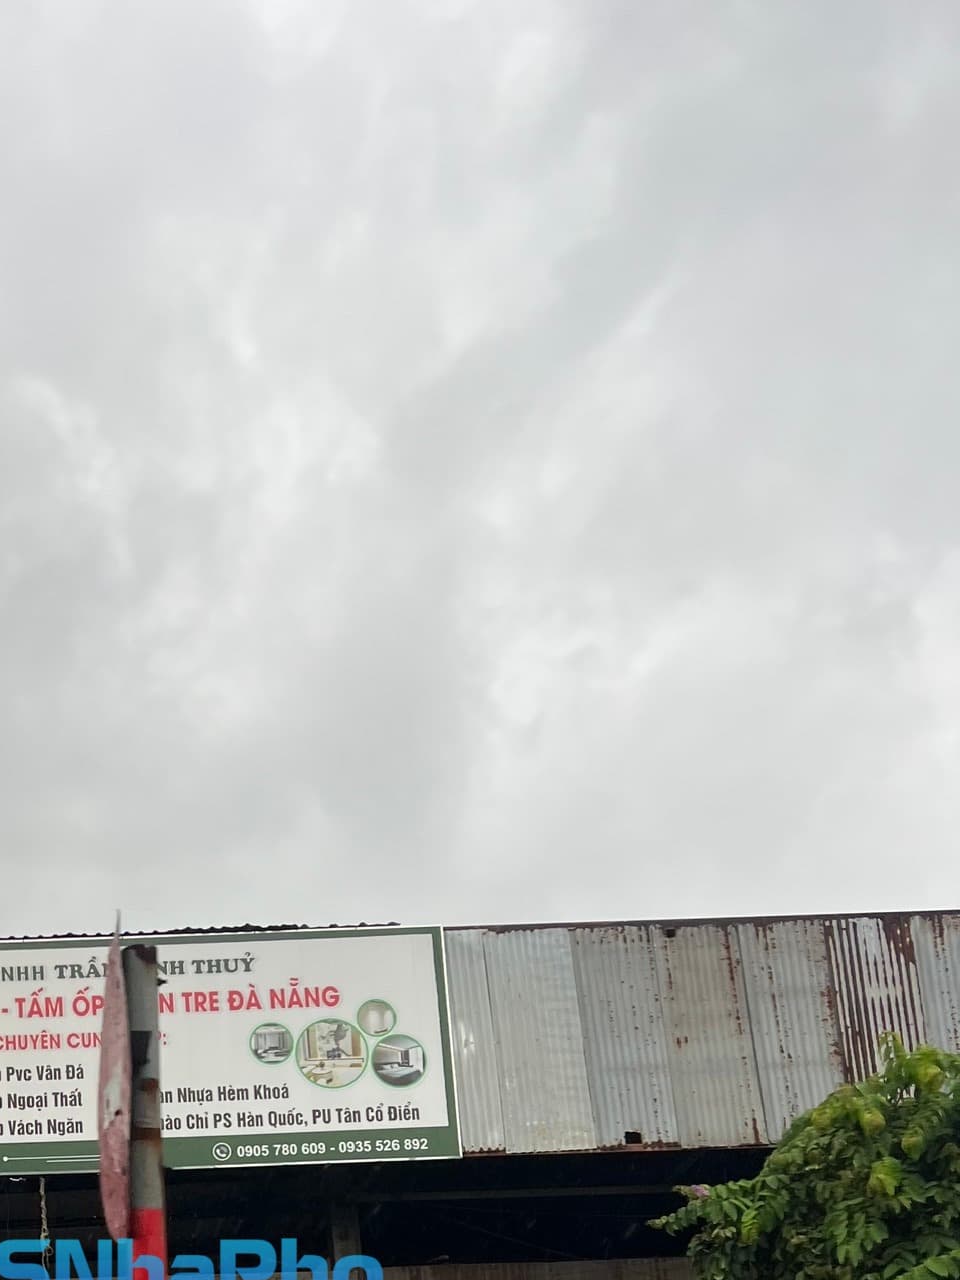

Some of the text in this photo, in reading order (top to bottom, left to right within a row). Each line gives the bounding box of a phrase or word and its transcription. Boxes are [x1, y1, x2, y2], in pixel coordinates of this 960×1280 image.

[192, 951, 255, 974] THUỶ
[15, 988, 64, 1018] TẤM
[72, 986, 106, 1016] ỐP
[182, 991, 220, 1013] TRE
[227, 983, 262, 1011] ĐÀ
[269, 977, 340, 1009] NẴNG
[67, 1031, 102, 1049] CUN
[6, 1067, 32, 1083] Pvc
[36, 1064, 62, 1081] Vân
[65, 1063, 84, 1081] Đá
[7, 1092, 50, 1111] Ngoại
[52, 1089, 83, 1108] Thất
[177, 1087, 213, 1106] Nhựa
[217, 1083, 249, 1101] Hèm
[254, 1082, 289, 1100] Khoá
[8, 1117, 42, 1136] Vách
[47, 1116, 83, 1135] Ngăn
[186, 1101, 420, 1130] Chỉ PS Hàn Quốc, PU Tân Cổ Điển
[237, 1138, 428, 1157] 0905 780 609 0935 526 892
